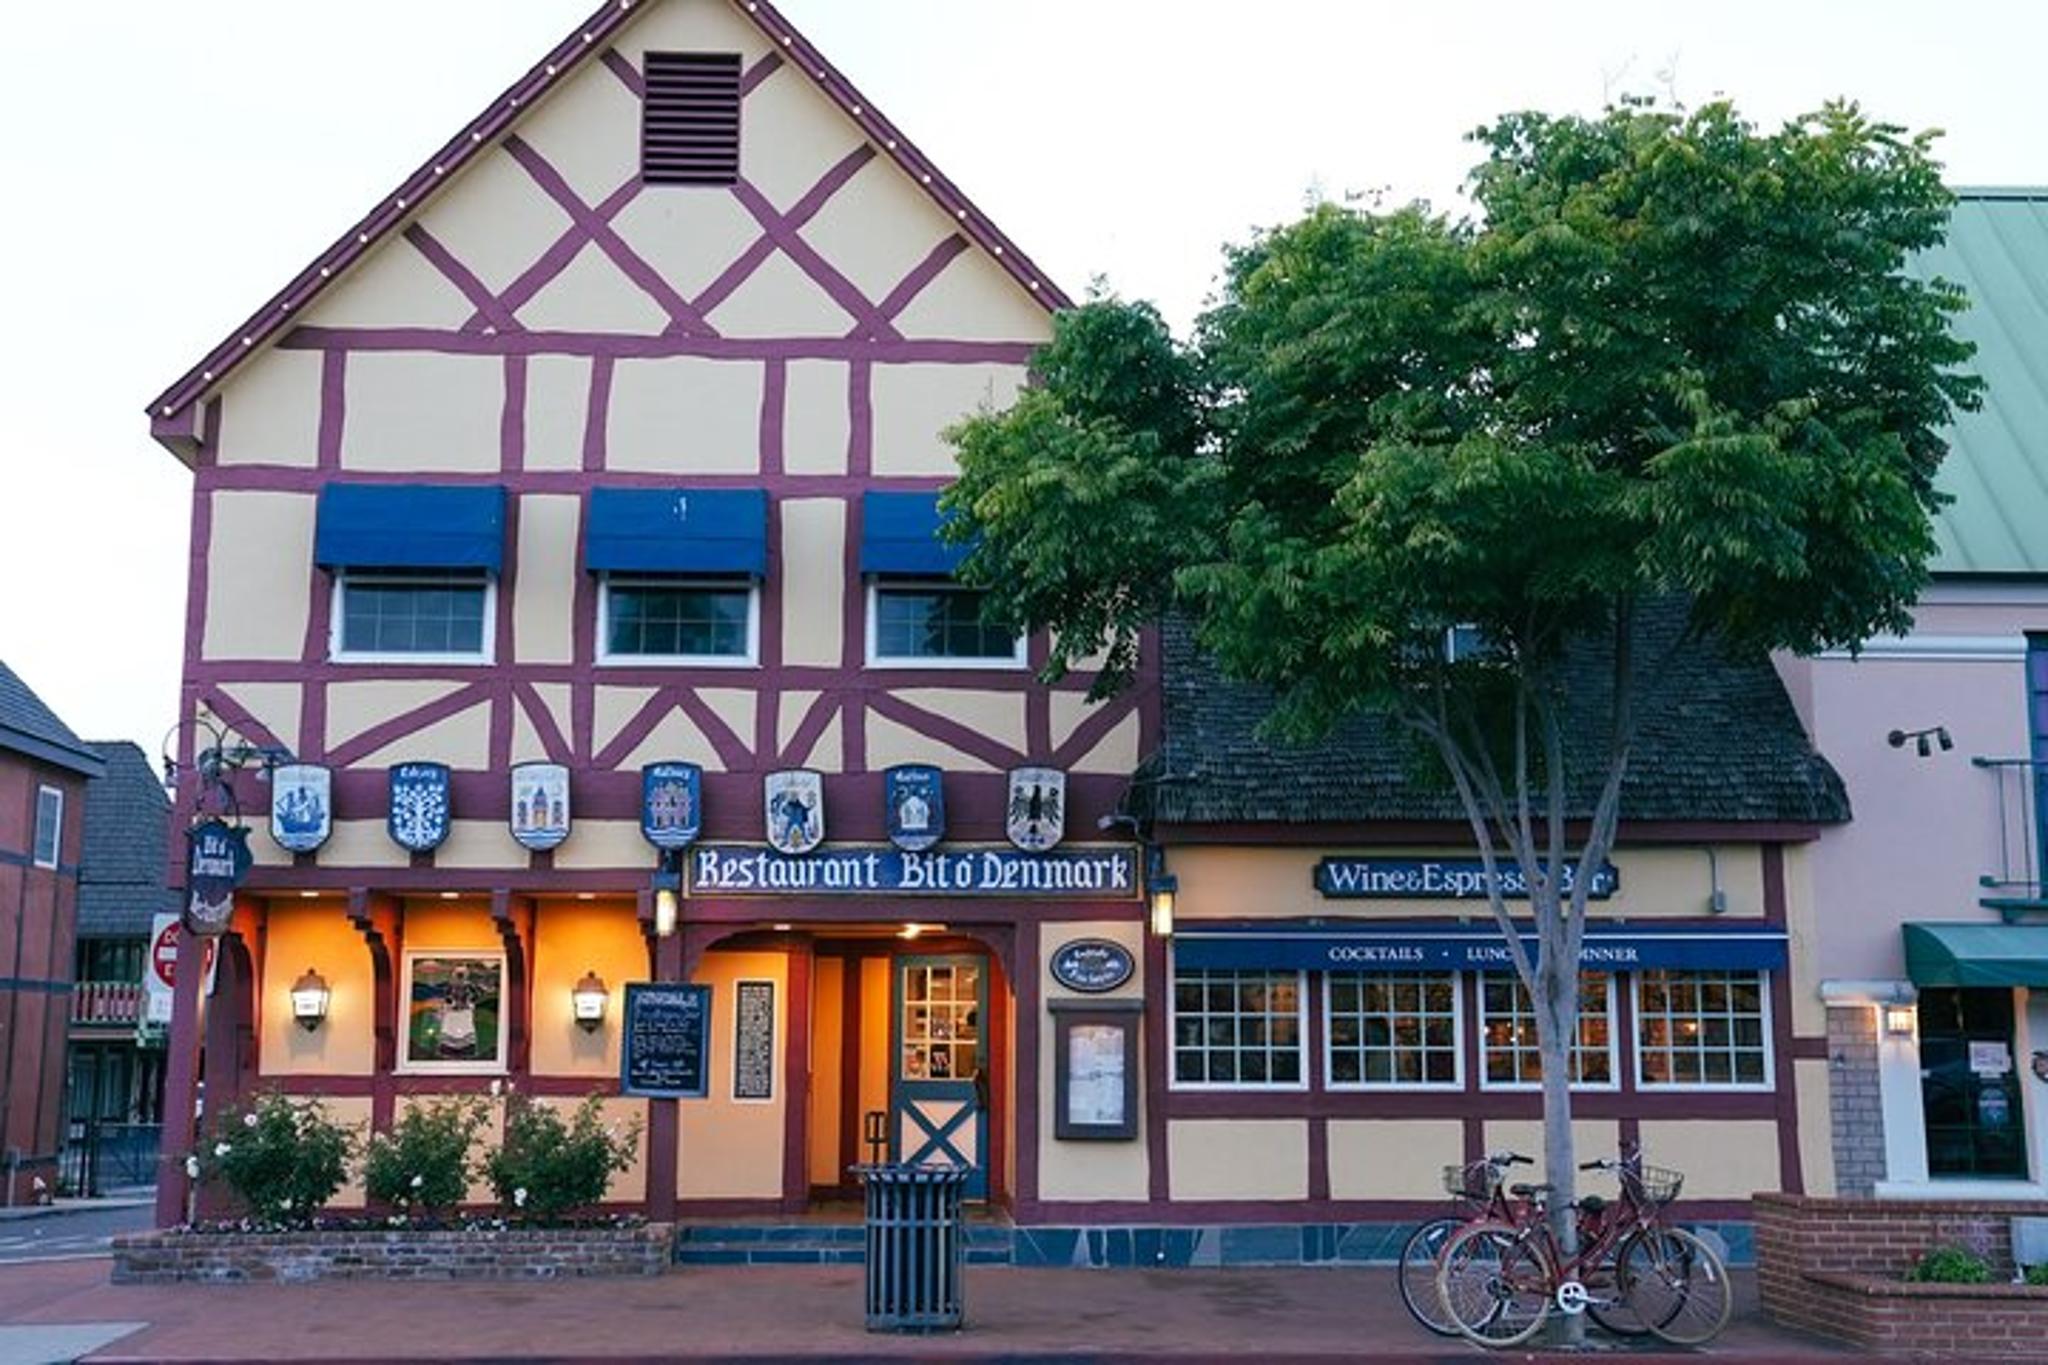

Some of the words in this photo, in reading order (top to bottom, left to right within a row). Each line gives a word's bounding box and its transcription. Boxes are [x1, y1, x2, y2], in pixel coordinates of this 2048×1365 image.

[697, 851, 880, 889] Restaurant
[899, 852, 950, 888] Bit
[979, 851, 1128, 889] Denmark
[1557, 864, 1605, 892] Br
[1328, 947, 1424, 961] COCKTAILS
[1466, 947, 1514, 961] LUNC
